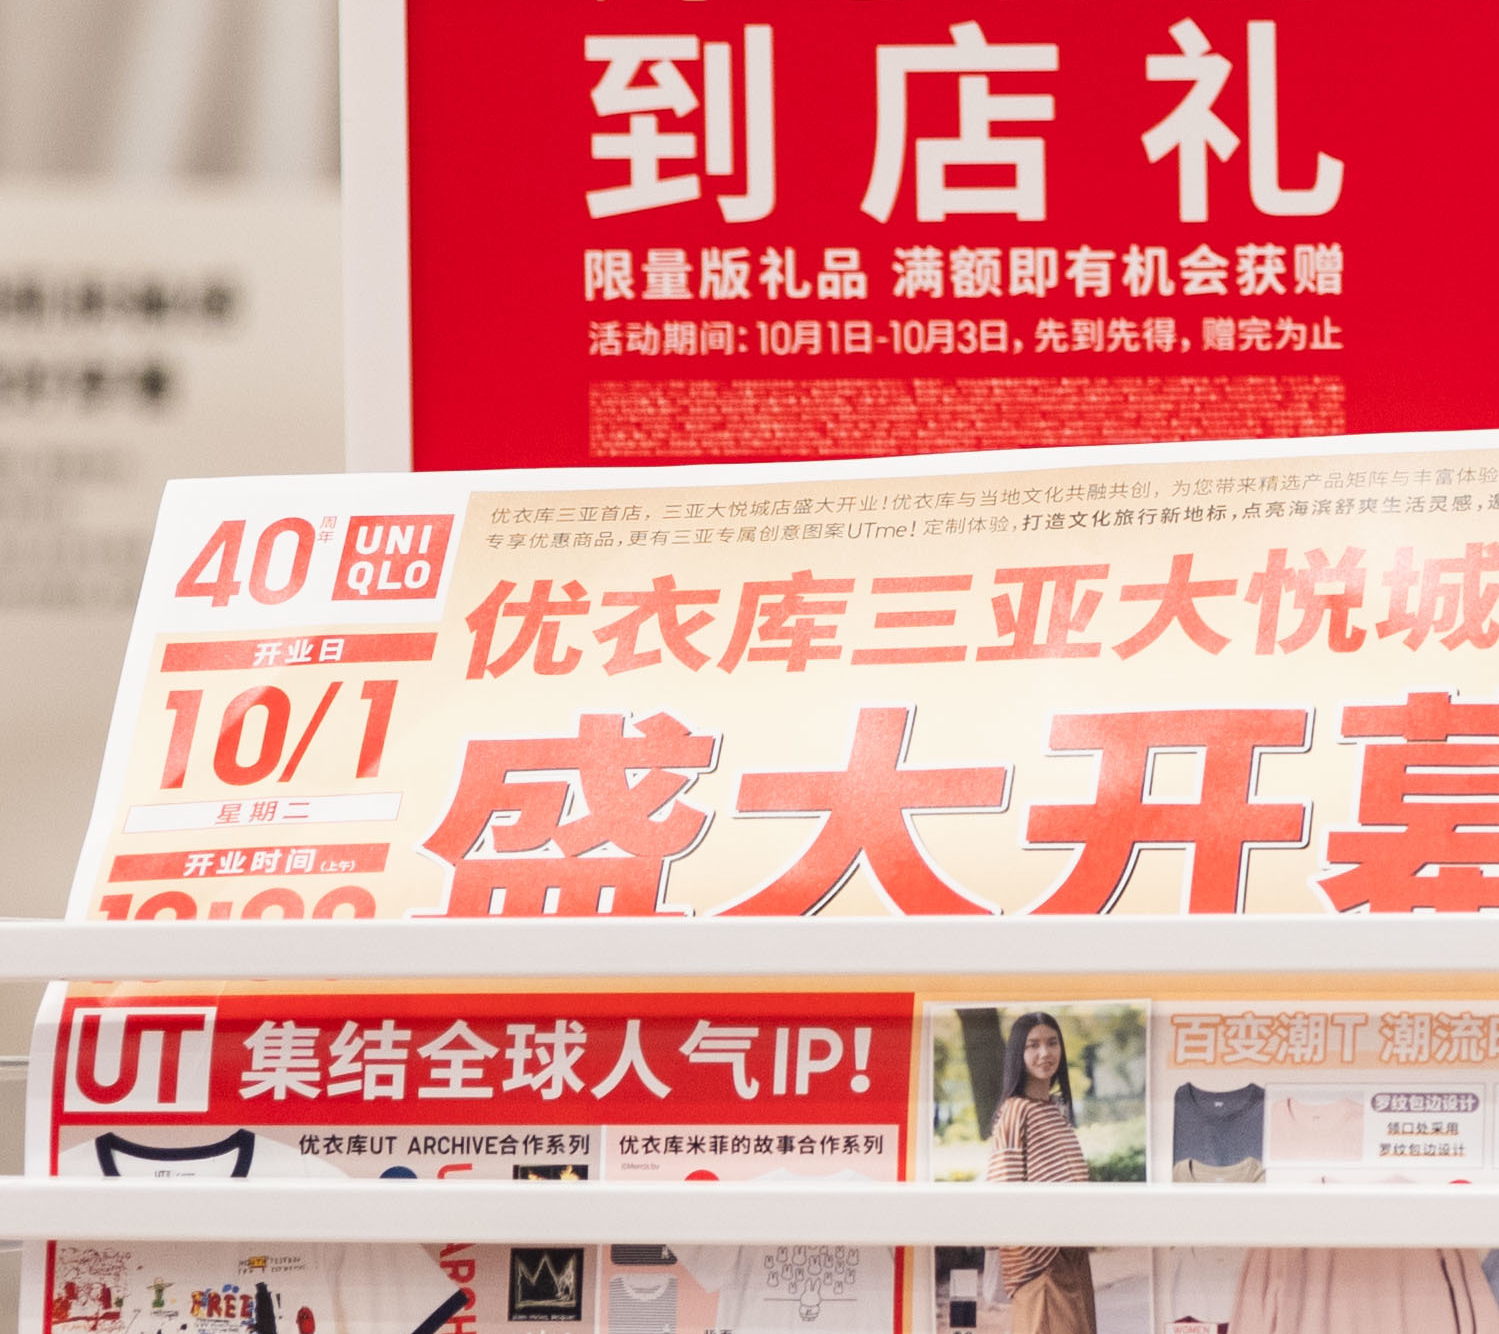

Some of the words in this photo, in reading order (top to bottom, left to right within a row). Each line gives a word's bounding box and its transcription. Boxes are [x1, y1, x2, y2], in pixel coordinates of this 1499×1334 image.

[583, 18, 1344, 224] 到店礼
[584, 246, 869, 301] 限量版礼品
[892, 244, 1345, 300] 满额即有机会获赠
[316, 514, 339, 545] 周年
[354, 524, 432, 556] UNI
[175, 516, 314, 608] 40
[347, 558, 433, 596] QLO
[254, 636, 345, 667] 开业日
[160, 679, 398, 790] 10/1
[215, 800, 310, 825] 星期二
[76, 1014, 204, 1105] UT
[239, 1019, 873, 1101] 集结全球人气IP!
[1171, 1012, 1369, 1065] 百变潮T
[299, 1133, 397, 1156] 优衣库UT
[408, 1133, 591, 1156] ARCHIVE合作系列
[619, 1134, 884, 1156] 优衣库米菲的故事合作系列
